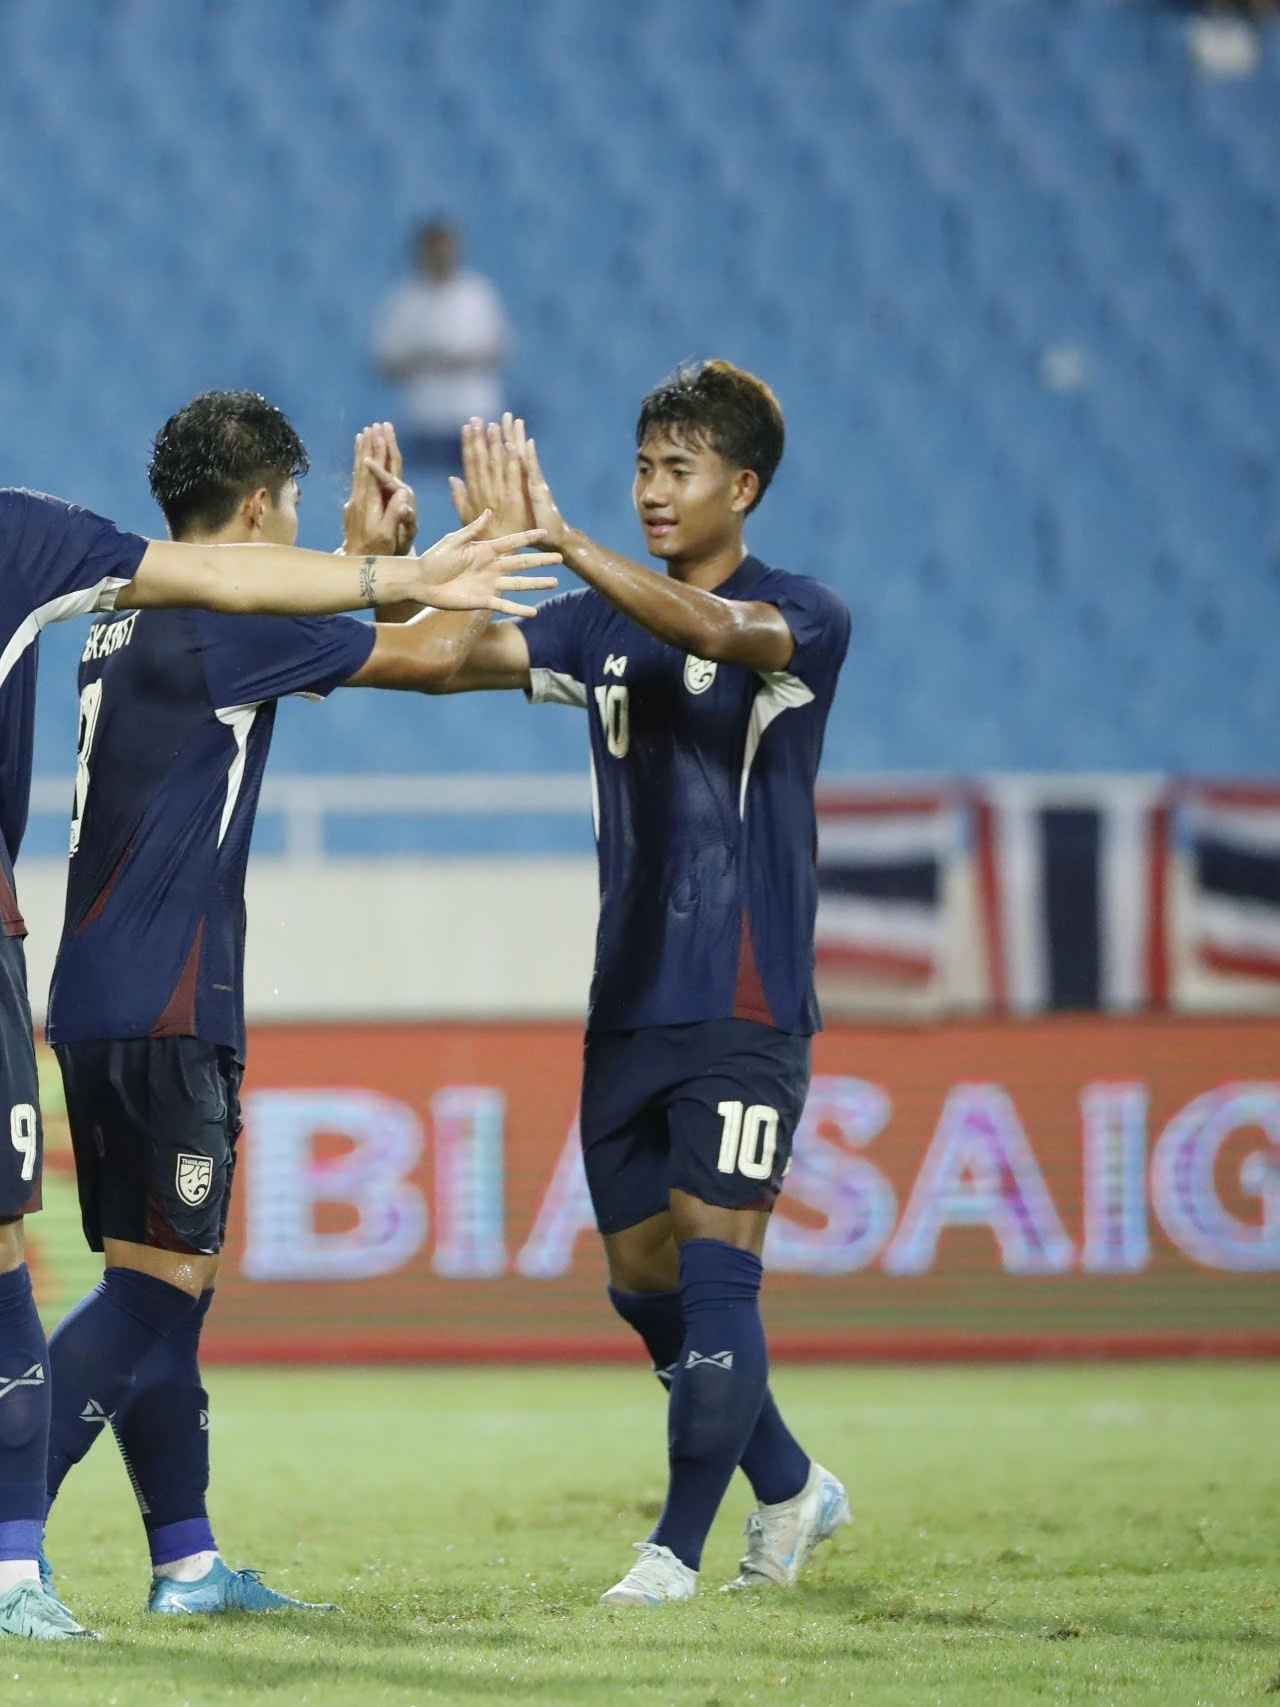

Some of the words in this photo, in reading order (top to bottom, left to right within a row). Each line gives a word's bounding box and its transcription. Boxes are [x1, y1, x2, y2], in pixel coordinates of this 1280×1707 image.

[594, 685, 629, 759] 10
[10, 1103, 37, 1181] 9
[717, 1100, 780, 1180] 10
